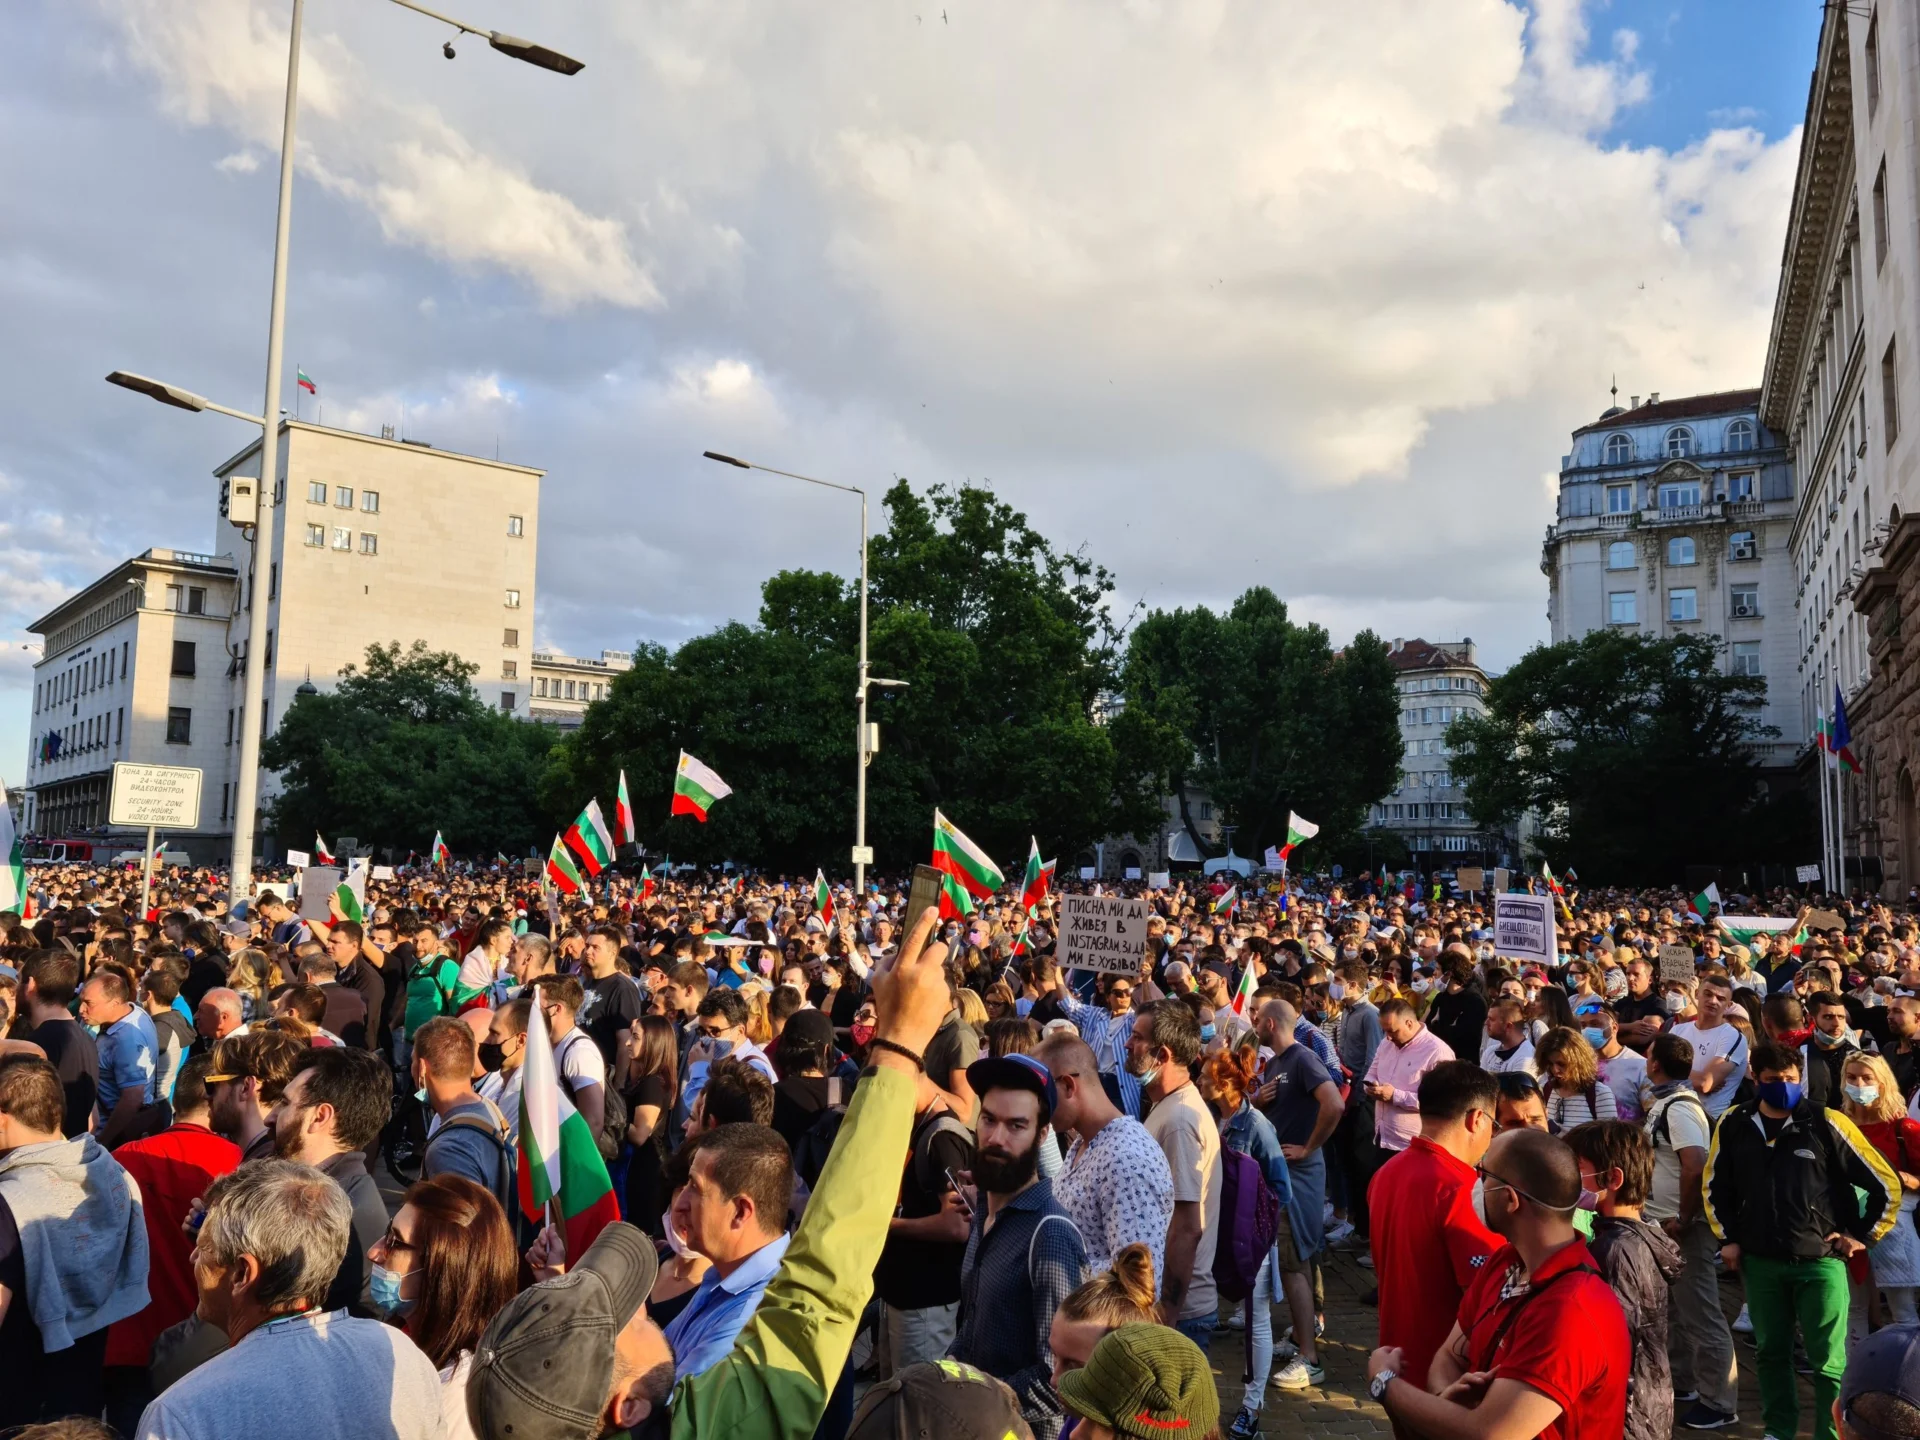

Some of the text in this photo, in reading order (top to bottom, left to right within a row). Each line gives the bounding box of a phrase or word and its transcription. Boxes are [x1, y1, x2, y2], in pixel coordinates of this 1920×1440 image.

[157, 771, 195, 780] СИГУРНОСТ
[139, 777, 176, 786] 24-ЧАСОВ
[130, 784, 184, 794] ВИДЕОКОНТРОЛ
[128, 798, 184, 808] SECURITY ZONE
[128, 813, 181, 823] VIDEO CONTROL
[1068, 899, 1143, 920] ПИСНА МИ ДА
[1070, 916, 1126, 933] ЖИВЕЯ В
[1499, 921, 1528, 933] БИЕЩОТО
[1067, 934, 1121, 954] INSTAGRAM,
[1132, 941, 1145, 955] ДА
[1503, 936, 1511, 945] НА
[1665, 948, 1687, 956] ИСКАМ
[1066, 950, 1141, 973] МИ Е ХУБАВО!
[1661, 969, 1666, 977] В
